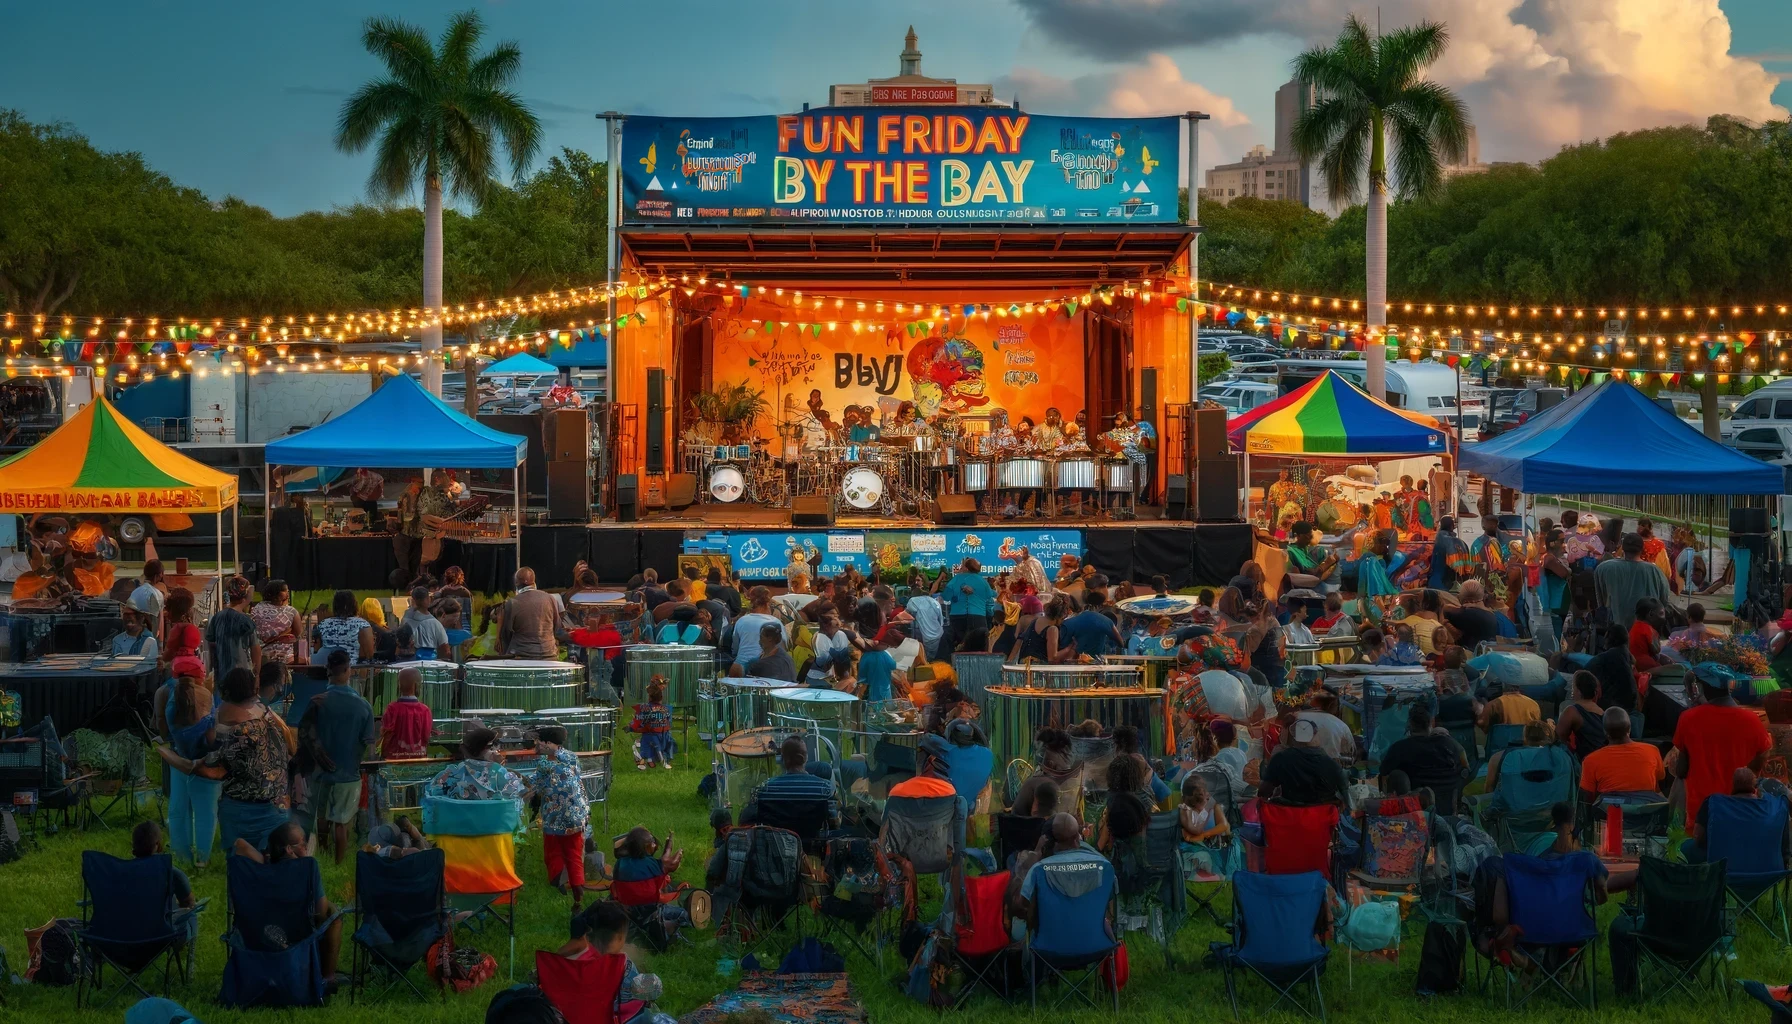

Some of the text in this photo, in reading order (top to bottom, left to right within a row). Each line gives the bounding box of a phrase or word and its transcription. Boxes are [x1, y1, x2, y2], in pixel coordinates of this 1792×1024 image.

[777, 114, 865, 154] FUN
[877, 114, 1031, 154] FRIDAY
[774, 156, 837, 204] BY
[844, 159, 930, 204] THE
[940, 159, 1036, 207] BAY
